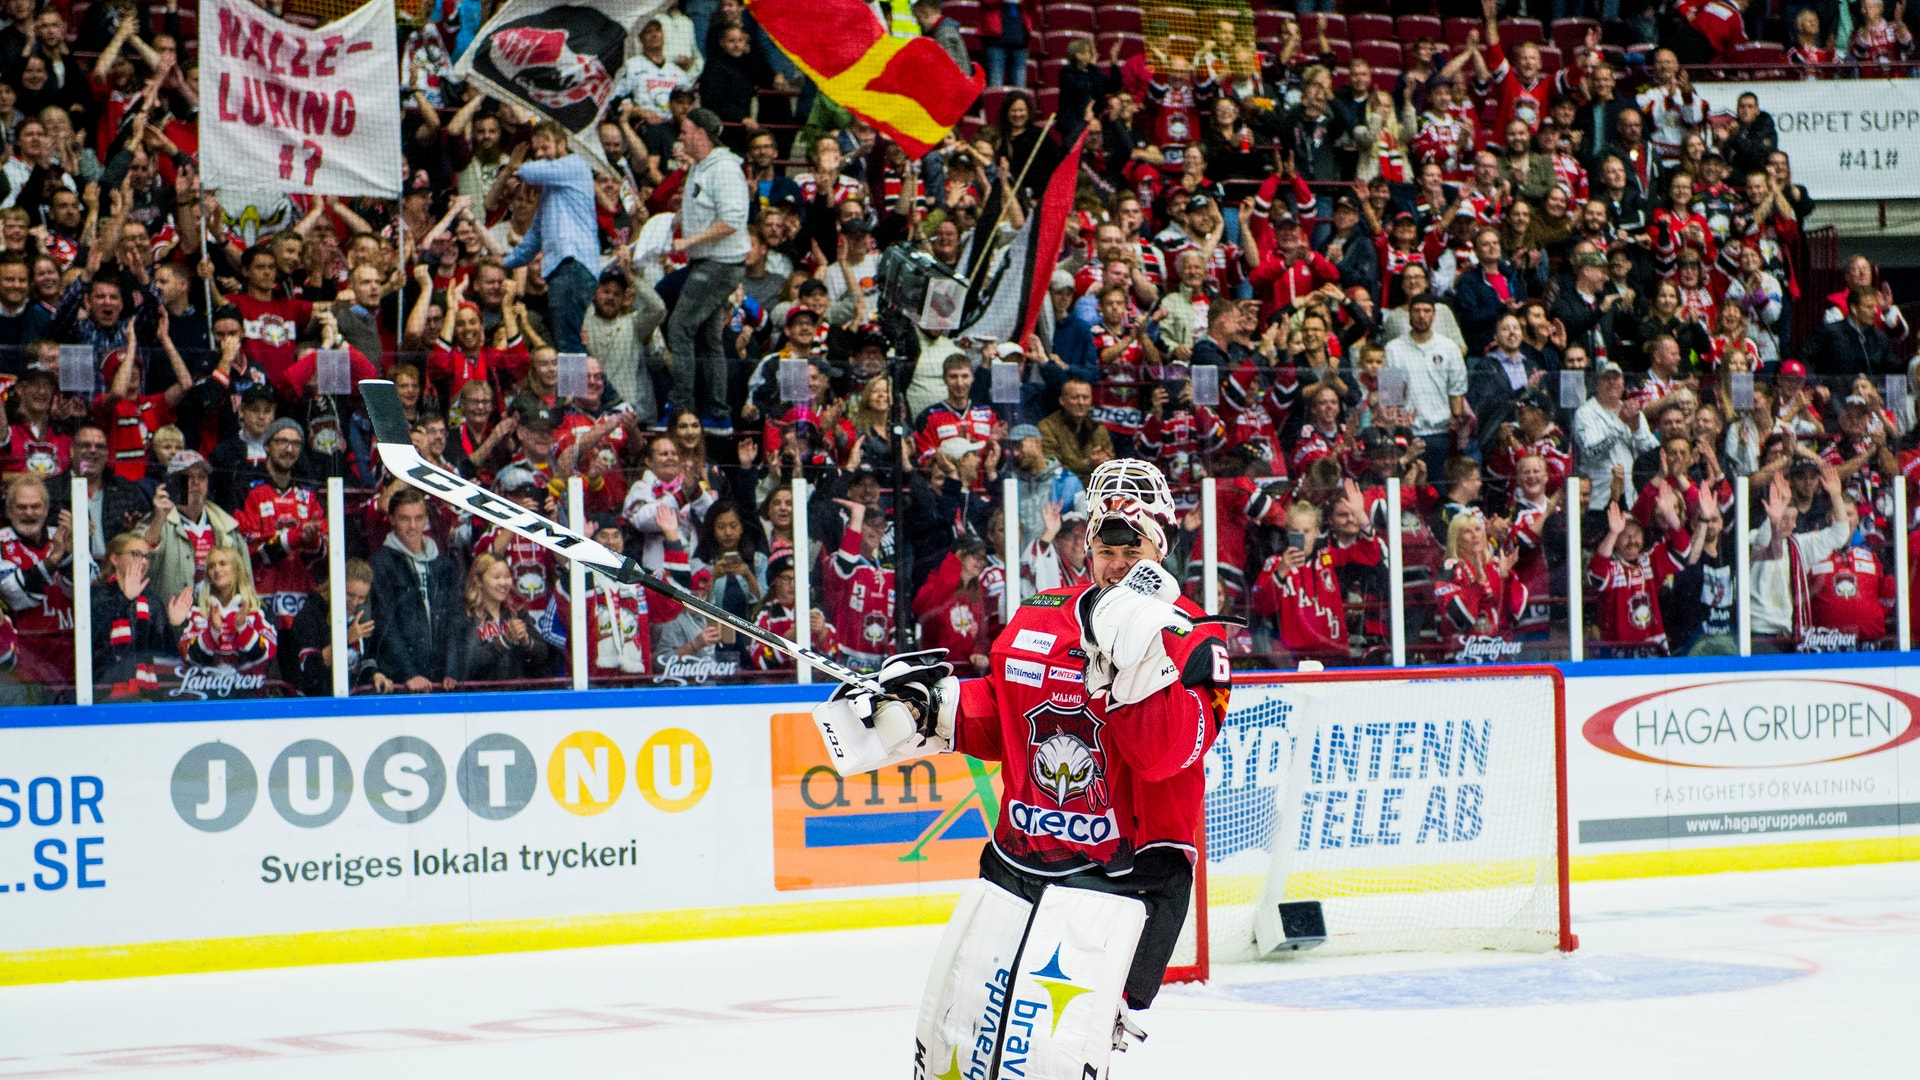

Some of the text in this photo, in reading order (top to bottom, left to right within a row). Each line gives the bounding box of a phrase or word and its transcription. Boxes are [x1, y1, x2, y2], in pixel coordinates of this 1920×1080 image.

[219, 72, 356, 137] LURING
[1773, 109, 1919, 133] ORPET SUPP
[279, 139, 323, 187] #7
[1839, 149, 1899, 170] #41#
[406, 462, 584, 550] CCM
[728, 615, 766, 636] PREMIER
[1797, 626, 1856, 654] Landgren
[1069, 648, 1086, 658] CC
[1211, 643, 1231, 683] 6
[1455, 634, 1522, 664] Landgren
[169, 663, 265, 700] Landgren
[653, 654, 738, 687] Landgren
[1160, 663, 1179, 677] CM
[1051, 691, 1083, 704] MALMÖ
[1636, 701, 1892, 747] HAGA GRUPPEN
[190, 738, 701, 823] JUST NU
[1655, 776, 1877, 805] FASTIGHETSFÖRVALTNING
[0, 775, 104, 828] SOR
[1297, 783, 1485, 851] TELE AB
[1012, 802, 1111, 844] areco
[1686, 810, 1848, 833] www.hagagruppen.com
[0, 836, 106, 892] .SE
[261, 839, 638, 887] Sveriges lokala tryckeri
[1000, 999, 1048, 1080] brav
